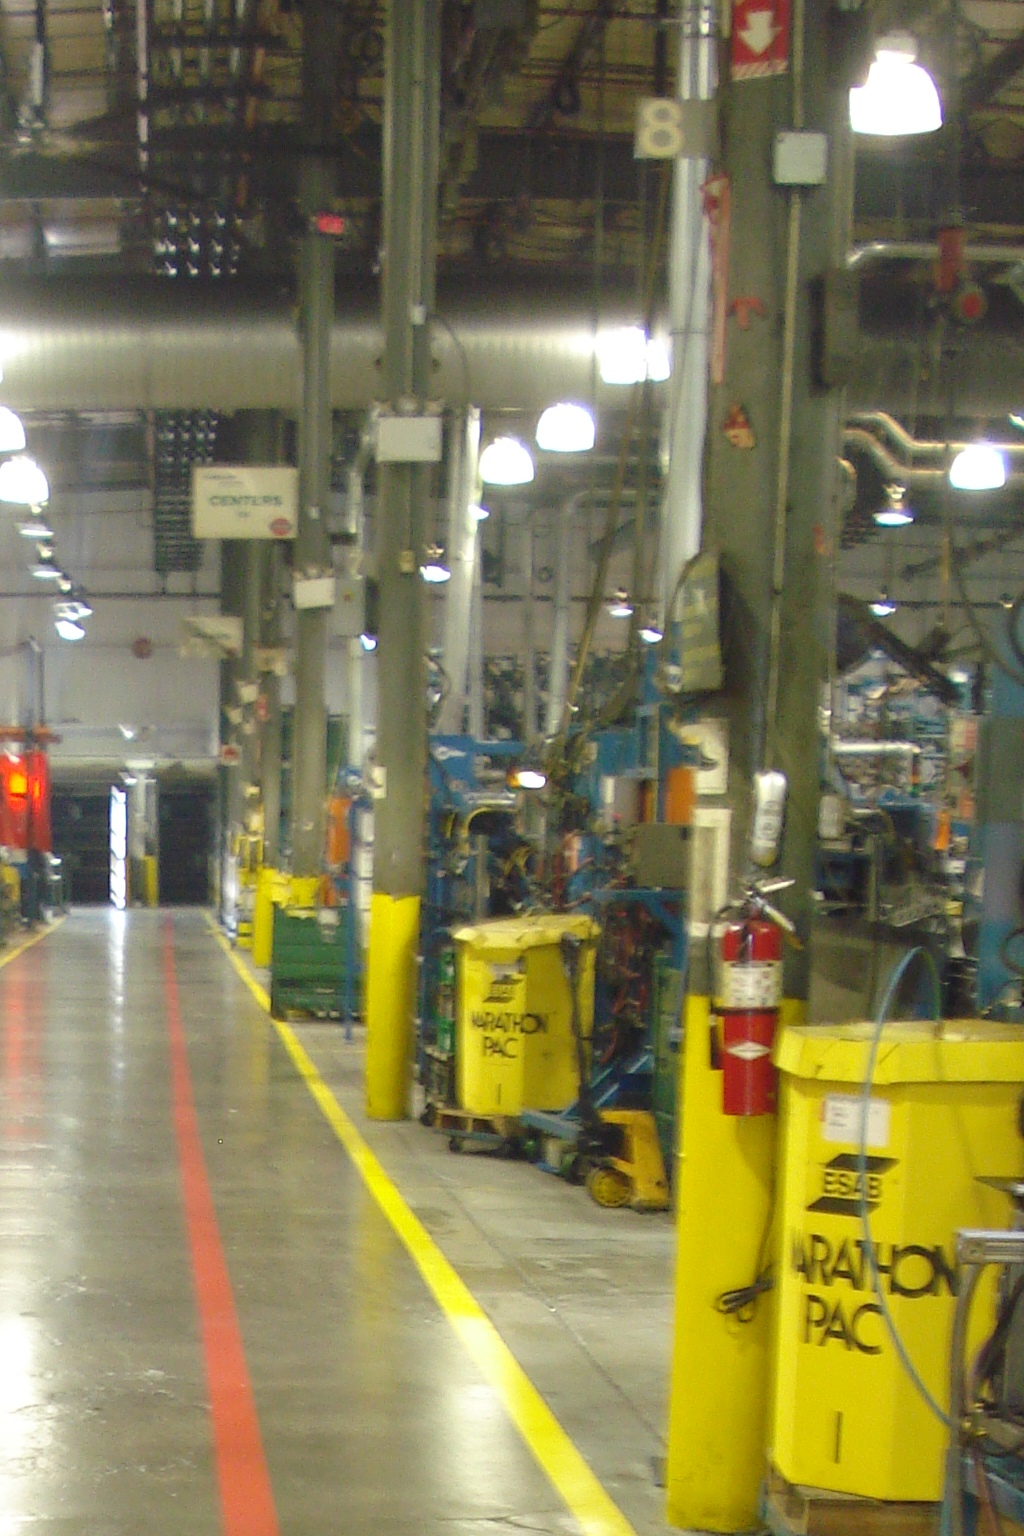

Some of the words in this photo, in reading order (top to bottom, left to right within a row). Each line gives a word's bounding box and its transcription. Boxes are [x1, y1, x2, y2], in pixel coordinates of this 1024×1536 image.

[639, 99, 682, 156] 8
[209, 494, 283, 507] CENTERS
[483, 1036, 518, 1058] PAC
[824, 1171, 883, 1198] ESAB
[802, 1294, 882, 1355] PAC
